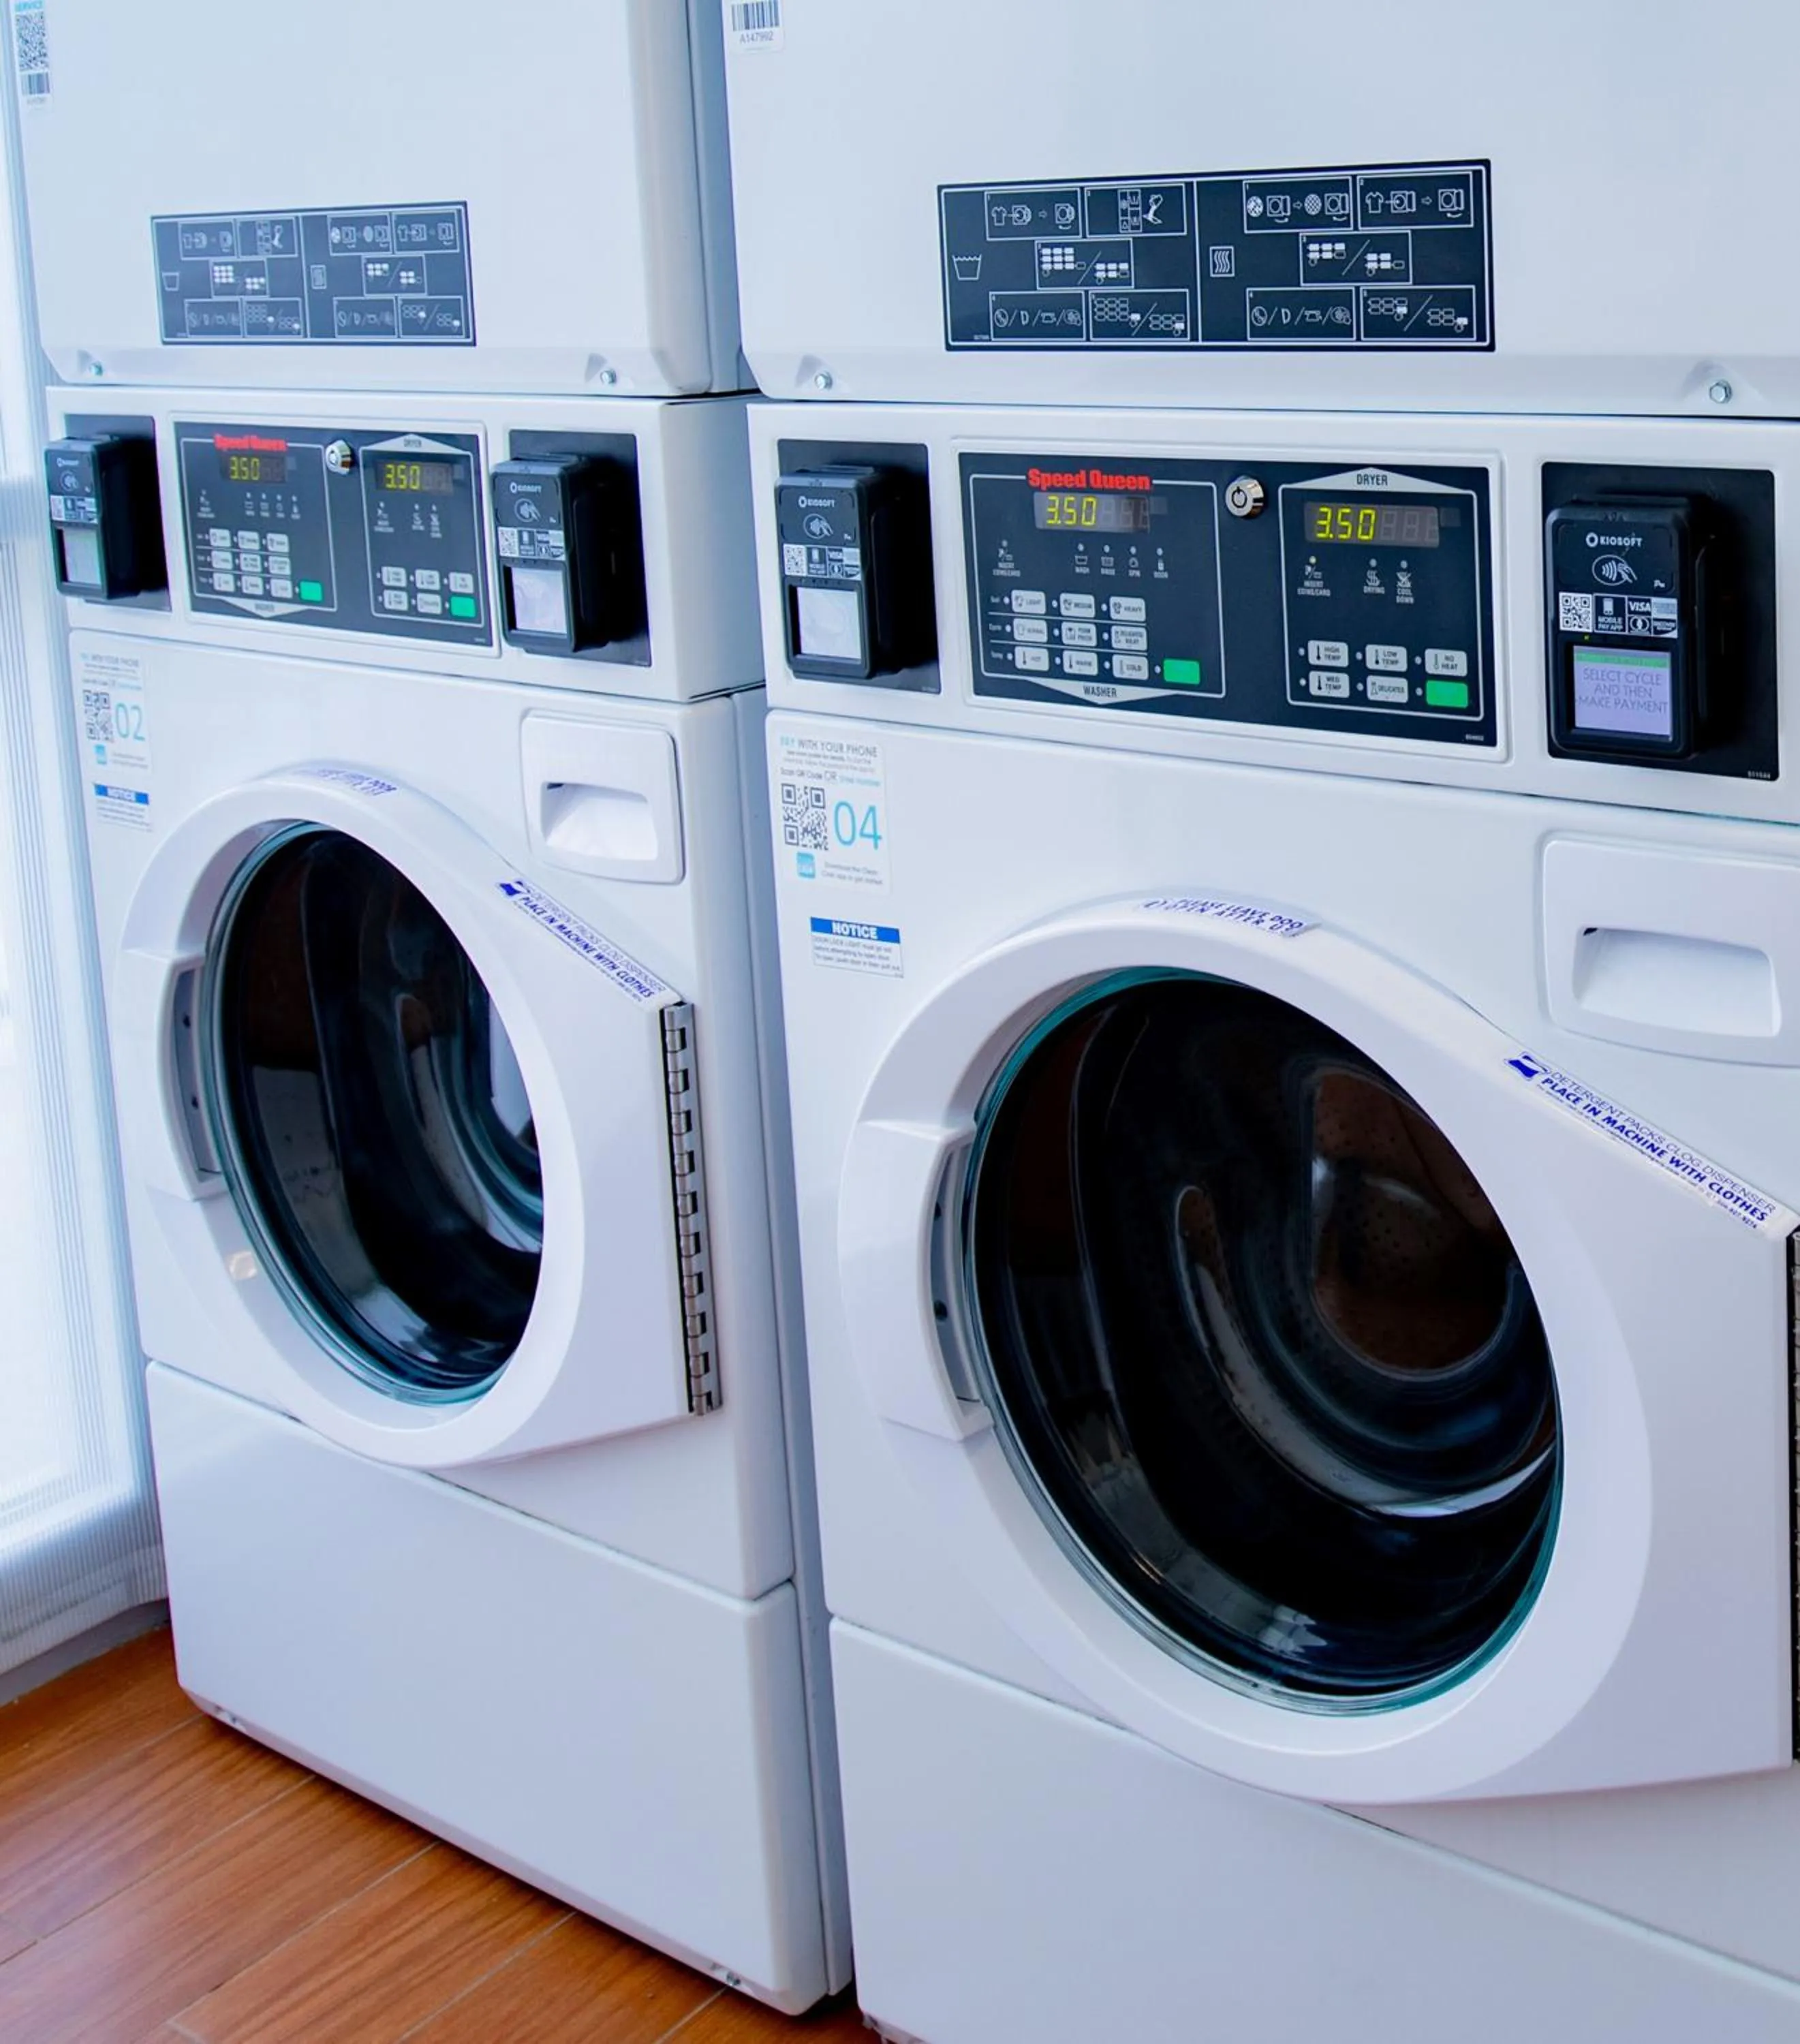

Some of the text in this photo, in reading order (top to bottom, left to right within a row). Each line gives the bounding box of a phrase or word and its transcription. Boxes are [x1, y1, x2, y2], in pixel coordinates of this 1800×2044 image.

[1027, 468, 1151, 491] Speed Queen
[1356, 474, 1388, 485] DRYER
[1046, 495, 1097, 526] 3.50
[1316, 506, 1376, 540] 3.50
[1600, 536, 1643, 547] KIOSOFT
[1628, 601, 1651, 612] VISA
[1598, 615, 1623, 623] MOBILE
[1583, 668, 1662, 686] SELECT CYCLE
[1083, 685, 1117, 698] WASHER
[1594, 684, 1653, 699] AND THEN
[1579, 696, 1668, 714] MAKE PAYMENT
[116, 703, 145, 741] 02
[798, 739, 818, 749] WITH
[820, 741, 843, 753] YOUR
[846, 744, 878, 758] PHONE
[835, 801, 882, 850] 04
[832, 922, 878, 939] NOTICE
[521, 896, 548, 916] PLACE
[544, 914, 557, 925] IN
[556, 923, 597, 954] MACHINE
[593, 953, 619, 971] WITH
[616, 970, 655, 999] CLOTHES
[1542, 1077, 1583, 1105] PLACE
[1583, 1103, 1602, 1117] IN
[1602, 1115, 1667, 1158] MACHINE
[1669, 1156, 1707, 1183] WITH
[1708, 1182, 1769, 1222] CLOTHES
[1551, 1071, 1625, 1118] DETERGENT
[1624, 1116, 1666, 1145] PACKS
[1666, 1143, 1702, 1167] CLOG
[1703, 1165, 1776, 1213] DISPENSER
